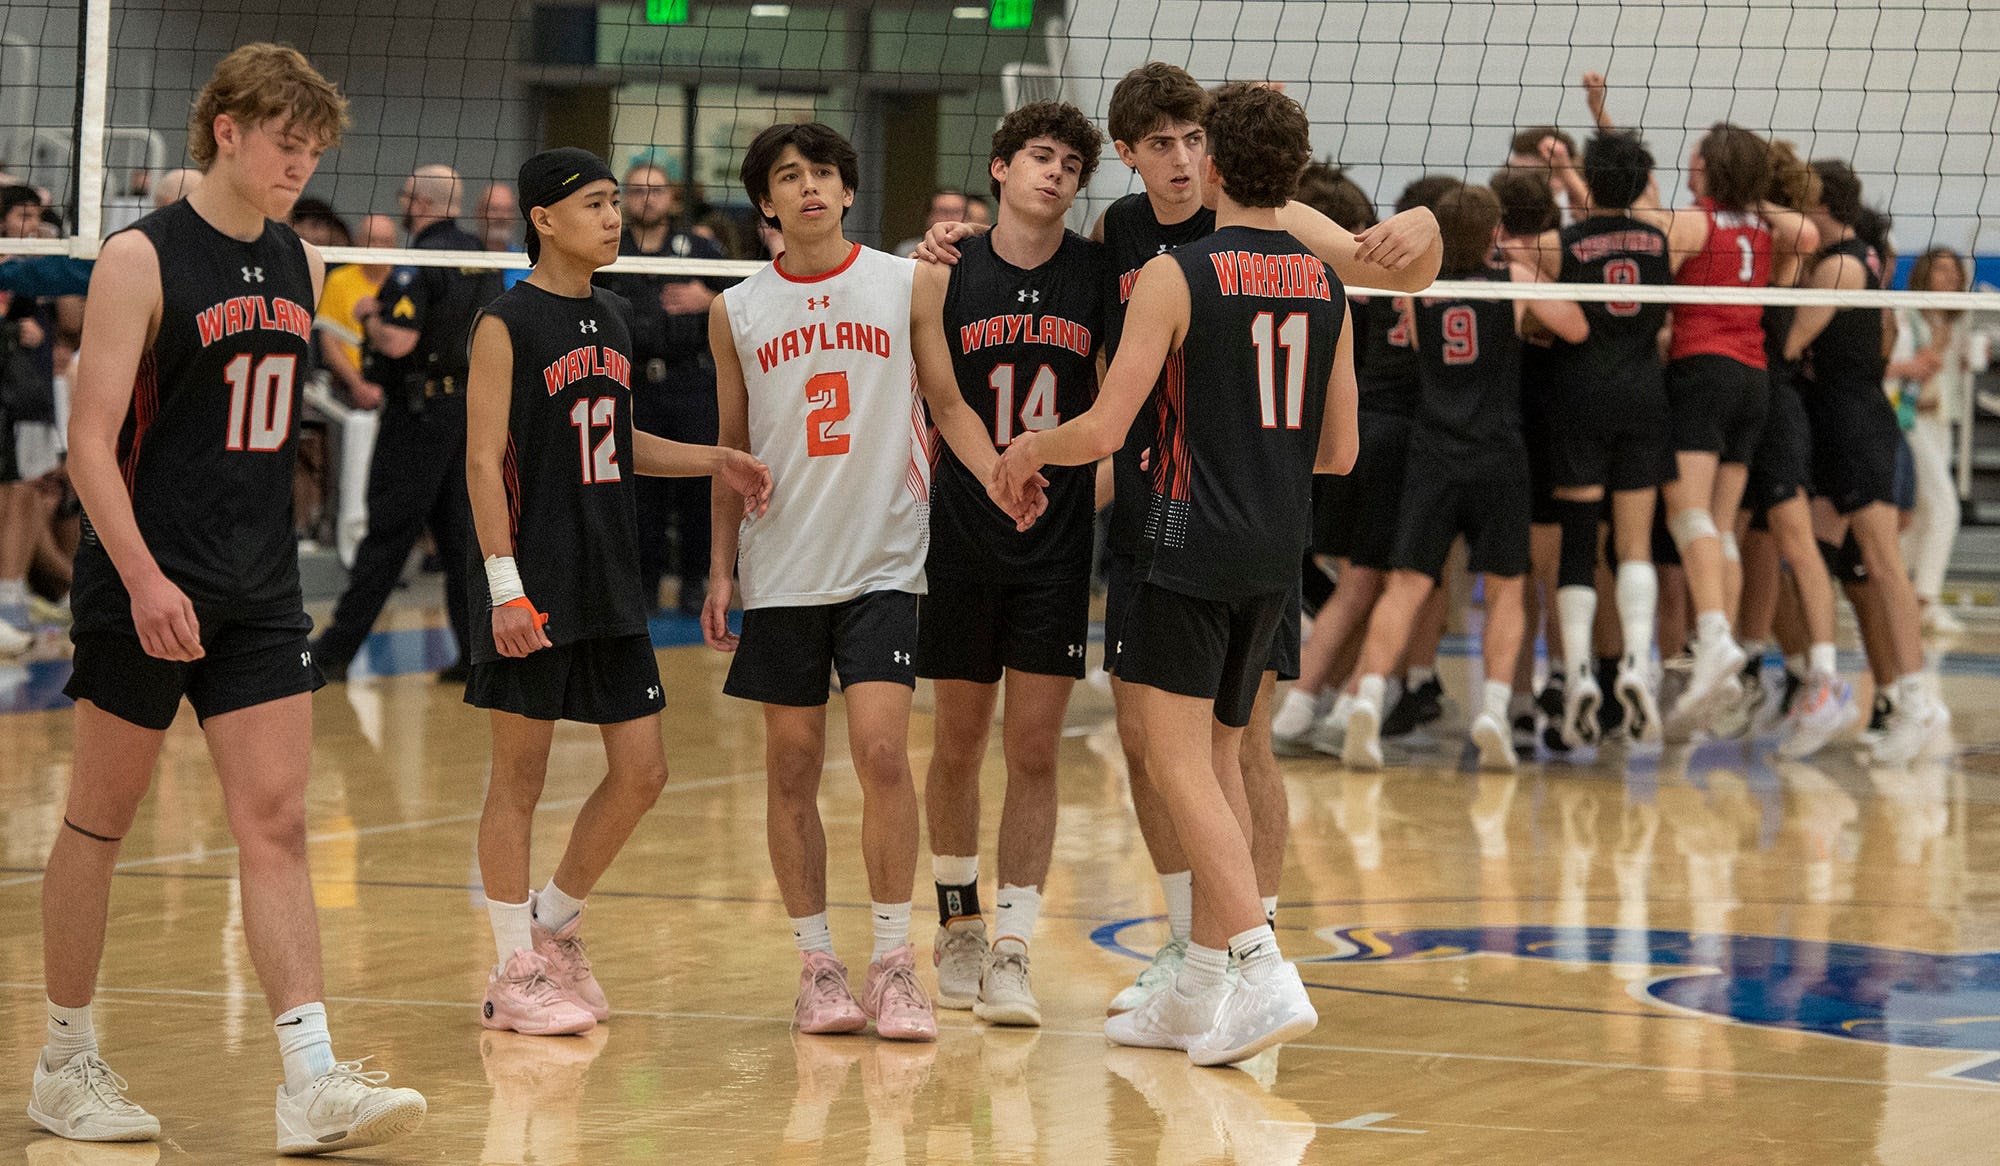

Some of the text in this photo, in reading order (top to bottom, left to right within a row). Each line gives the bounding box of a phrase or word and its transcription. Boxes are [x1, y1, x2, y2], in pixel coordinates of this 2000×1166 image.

[1209, 251, 1331, 301] WARRIORS
[1736, 234, 1754, 282] 1
[756, 321, 890, 374] WAYLAND
[960, 314, 1091, 358] WAYLAND
[1251, 311, 1309, 429] 11
[1442, 305, 1479, 365] 9
[223, 353, 297, 452] 10
[805, 371, 850, 457] 2
[988, 363, 1061, 447] 14
[570, 396, 621, 485] 12
